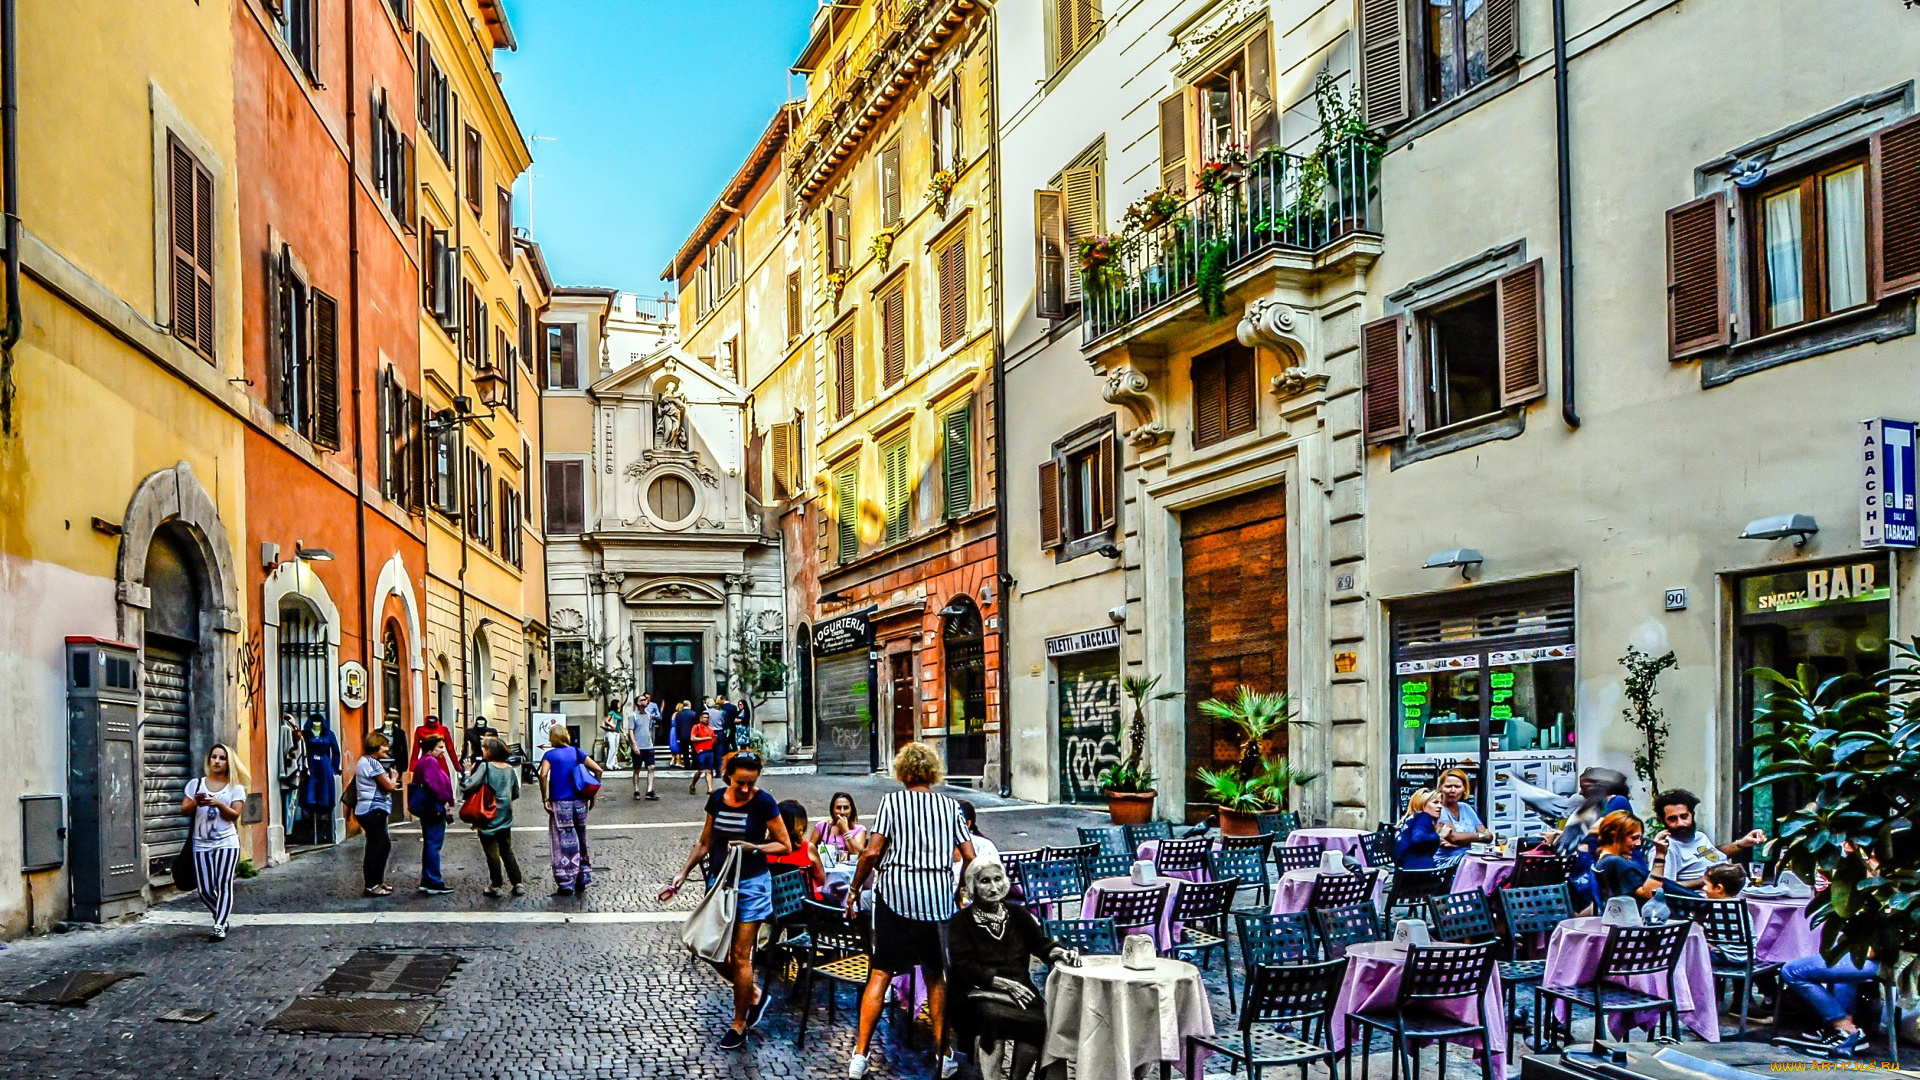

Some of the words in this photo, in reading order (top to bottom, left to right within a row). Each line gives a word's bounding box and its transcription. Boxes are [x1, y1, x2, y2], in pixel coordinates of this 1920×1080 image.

[1864, 421, 1877, 535] TABACCHI
[1885, 427, 1910, 509] T
[1885, 524, 1916, 541] TABACCHI
[1337, 575, 1352, 589] 89
[1807, 563, 1875, 602] BAR
[1667, 593, 1683, 606] 90
[813, 617, 865, 647] YOGURTERIA
[1047, 636, 1074, 654] FILETTI
